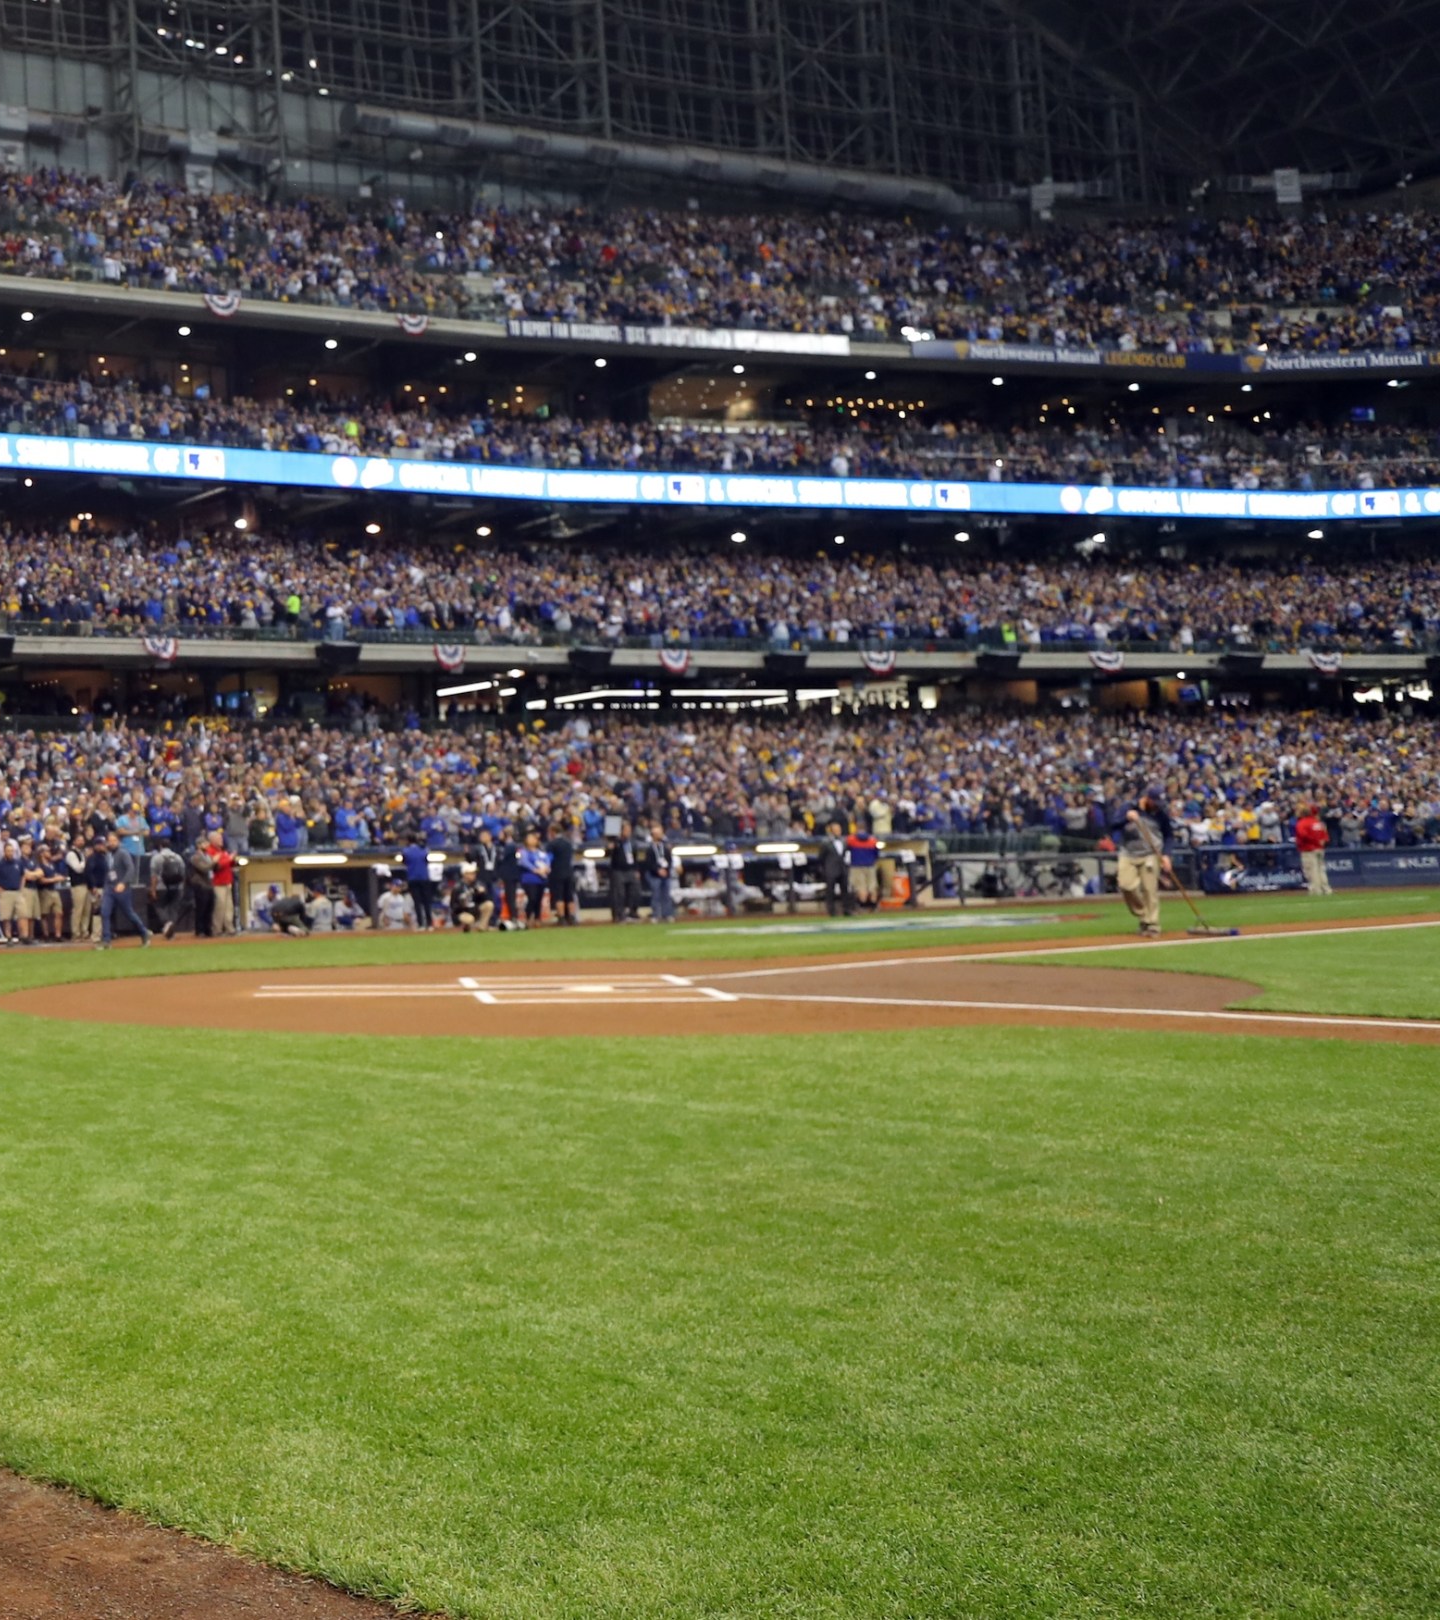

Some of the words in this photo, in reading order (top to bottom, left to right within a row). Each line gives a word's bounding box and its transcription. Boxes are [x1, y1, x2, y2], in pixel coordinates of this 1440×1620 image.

[970, 345, 1055, 362] Northwestern
[1056, 348, 1101, 364] Mutual
[1105, 352, 1154, 367] LEGENDS
[1265, 354, 1367, 370] Northwestern
[1369, 351, 1424, 367] Mutual
